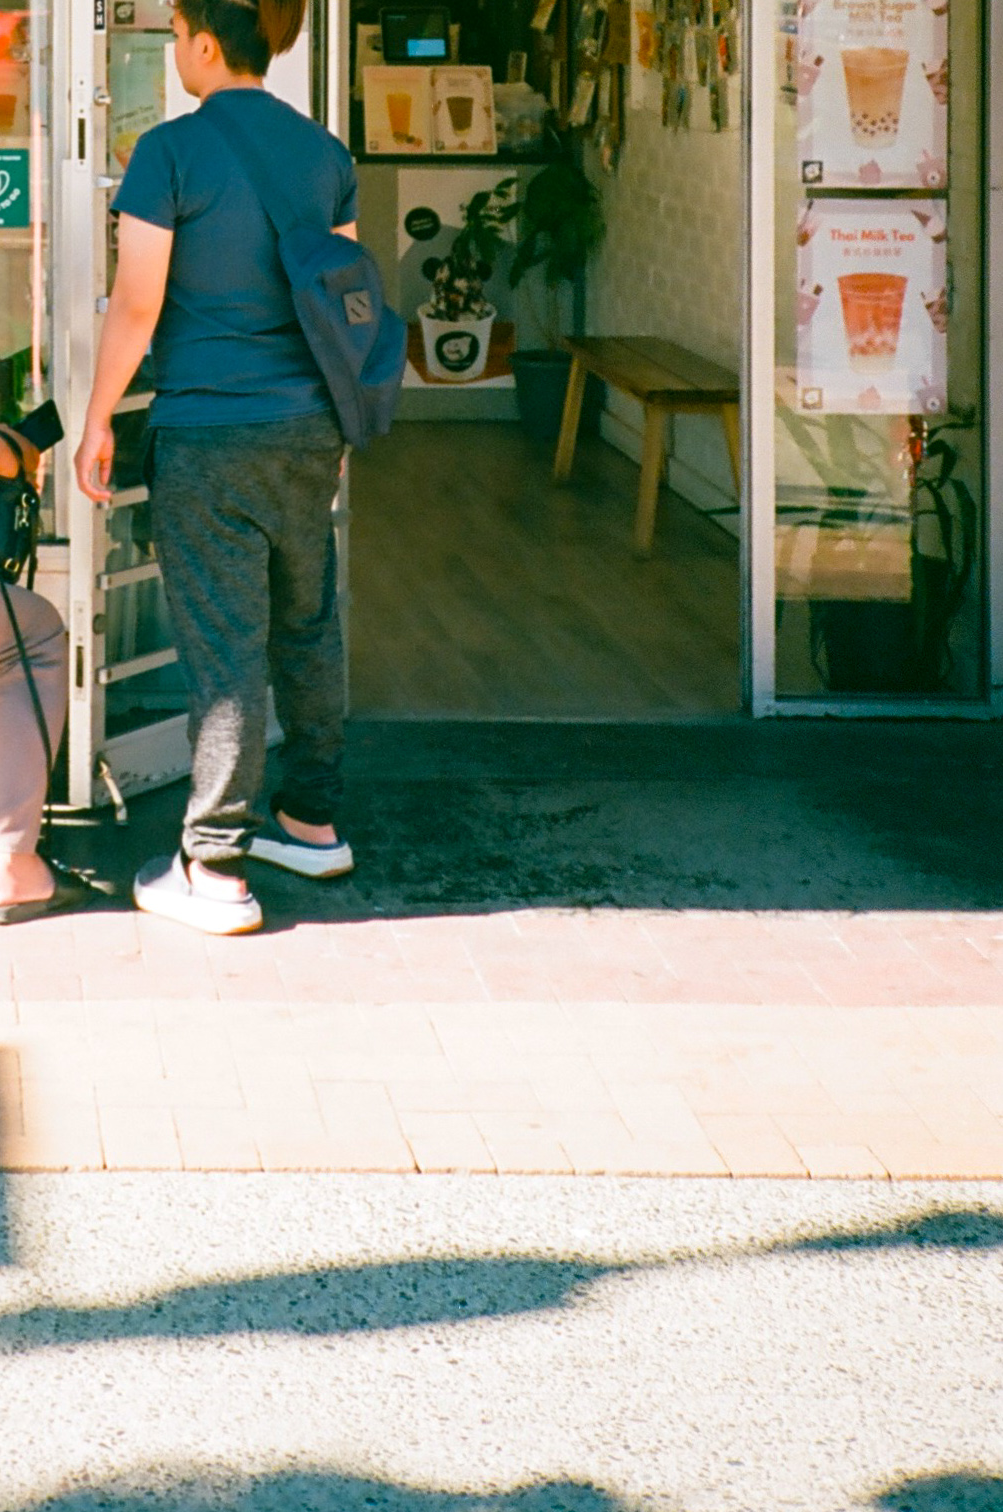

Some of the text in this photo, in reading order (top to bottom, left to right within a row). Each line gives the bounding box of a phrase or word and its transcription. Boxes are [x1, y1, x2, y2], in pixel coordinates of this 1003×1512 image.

[830, 228, 915, 241] Thai Milk Tea
